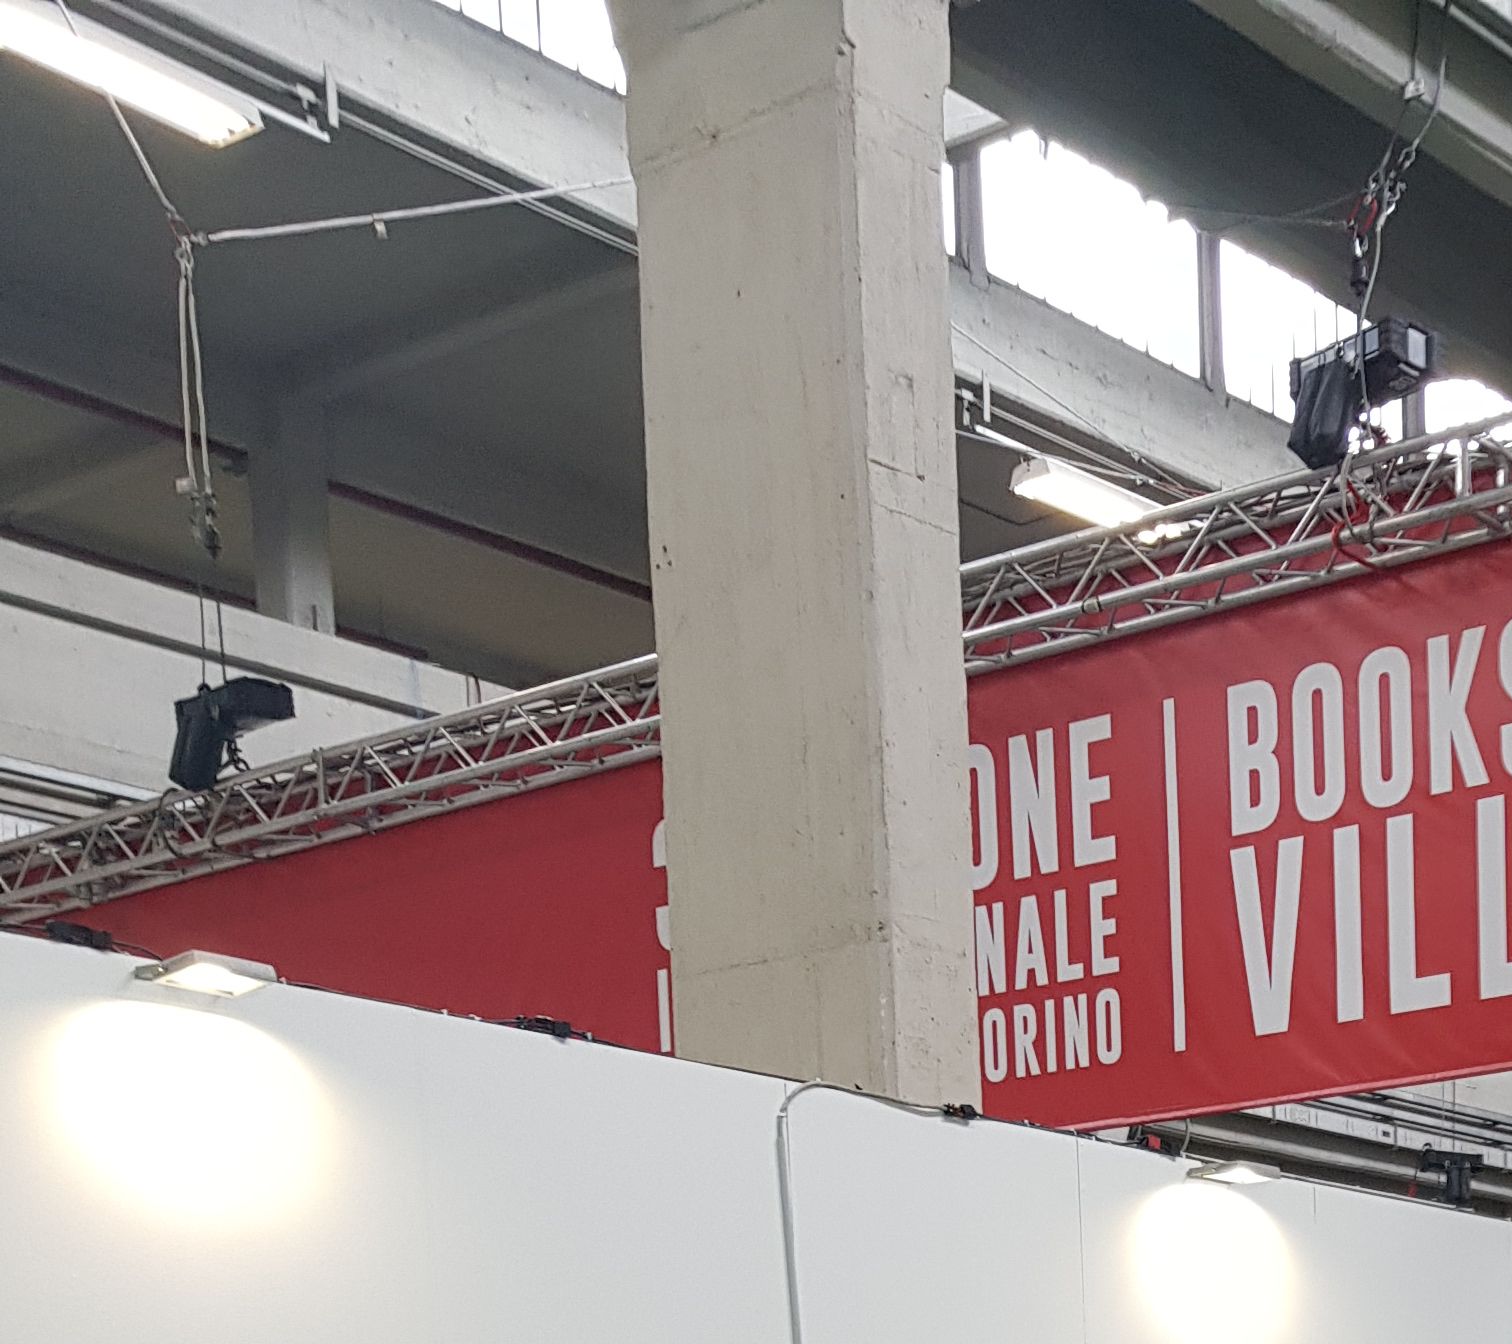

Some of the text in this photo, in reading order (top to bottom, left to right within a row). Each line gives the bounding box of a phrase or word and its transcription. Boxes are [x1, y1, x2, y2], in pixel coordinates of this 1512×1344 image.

[968, 713, 1117, 891] ONE
[974, 879, 1120, 997] NALE
[982, 988, 1122, 1083] ORINO
